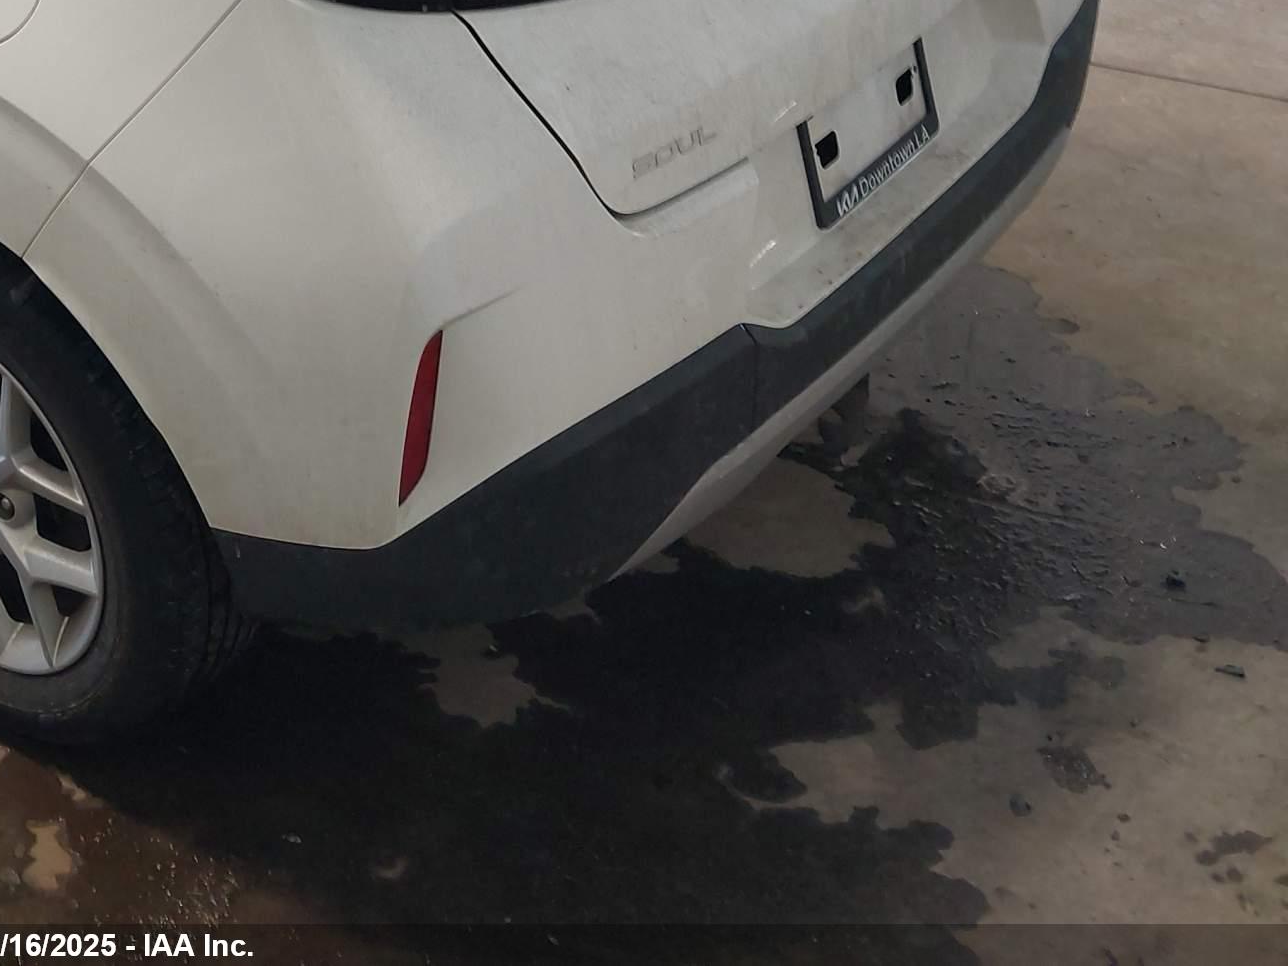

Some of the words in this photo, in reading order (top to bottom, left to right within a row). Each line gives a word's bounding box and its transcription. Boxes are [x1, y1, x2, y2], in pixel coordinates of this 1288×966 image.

[632, 128, 718, 180] SOUL
[858, 139, 918, 198] Downtown
[913, 123, 931, 149] LA
